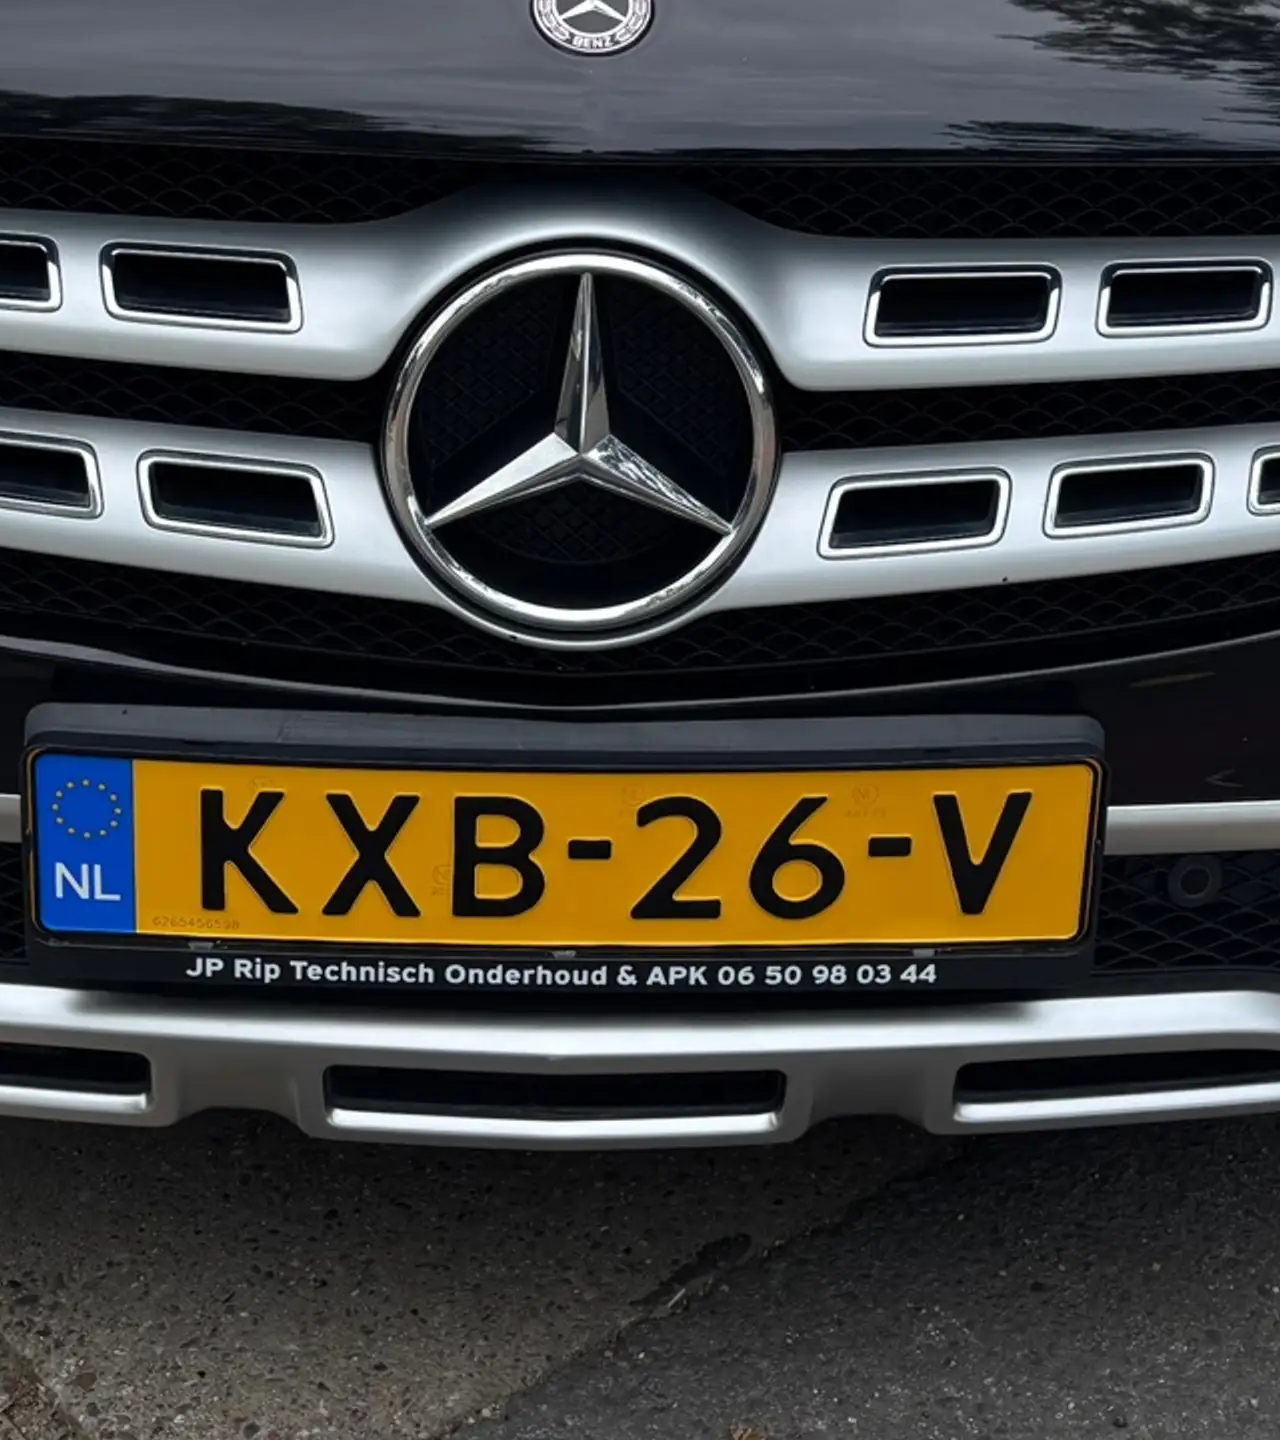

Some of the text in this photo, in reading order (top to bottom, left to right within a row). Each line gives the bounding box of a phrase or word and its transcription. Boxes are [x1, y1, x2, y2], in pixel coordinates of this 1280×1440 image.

[572, 35, 615, 49] BENZ
[200, 789, 1032, 920] KXB-26-V
[55, 862, 121, 901] NL
[186, 957, 937, 986] JP Rip Technisch Onderhoud & APK 06 50 98 03 44
